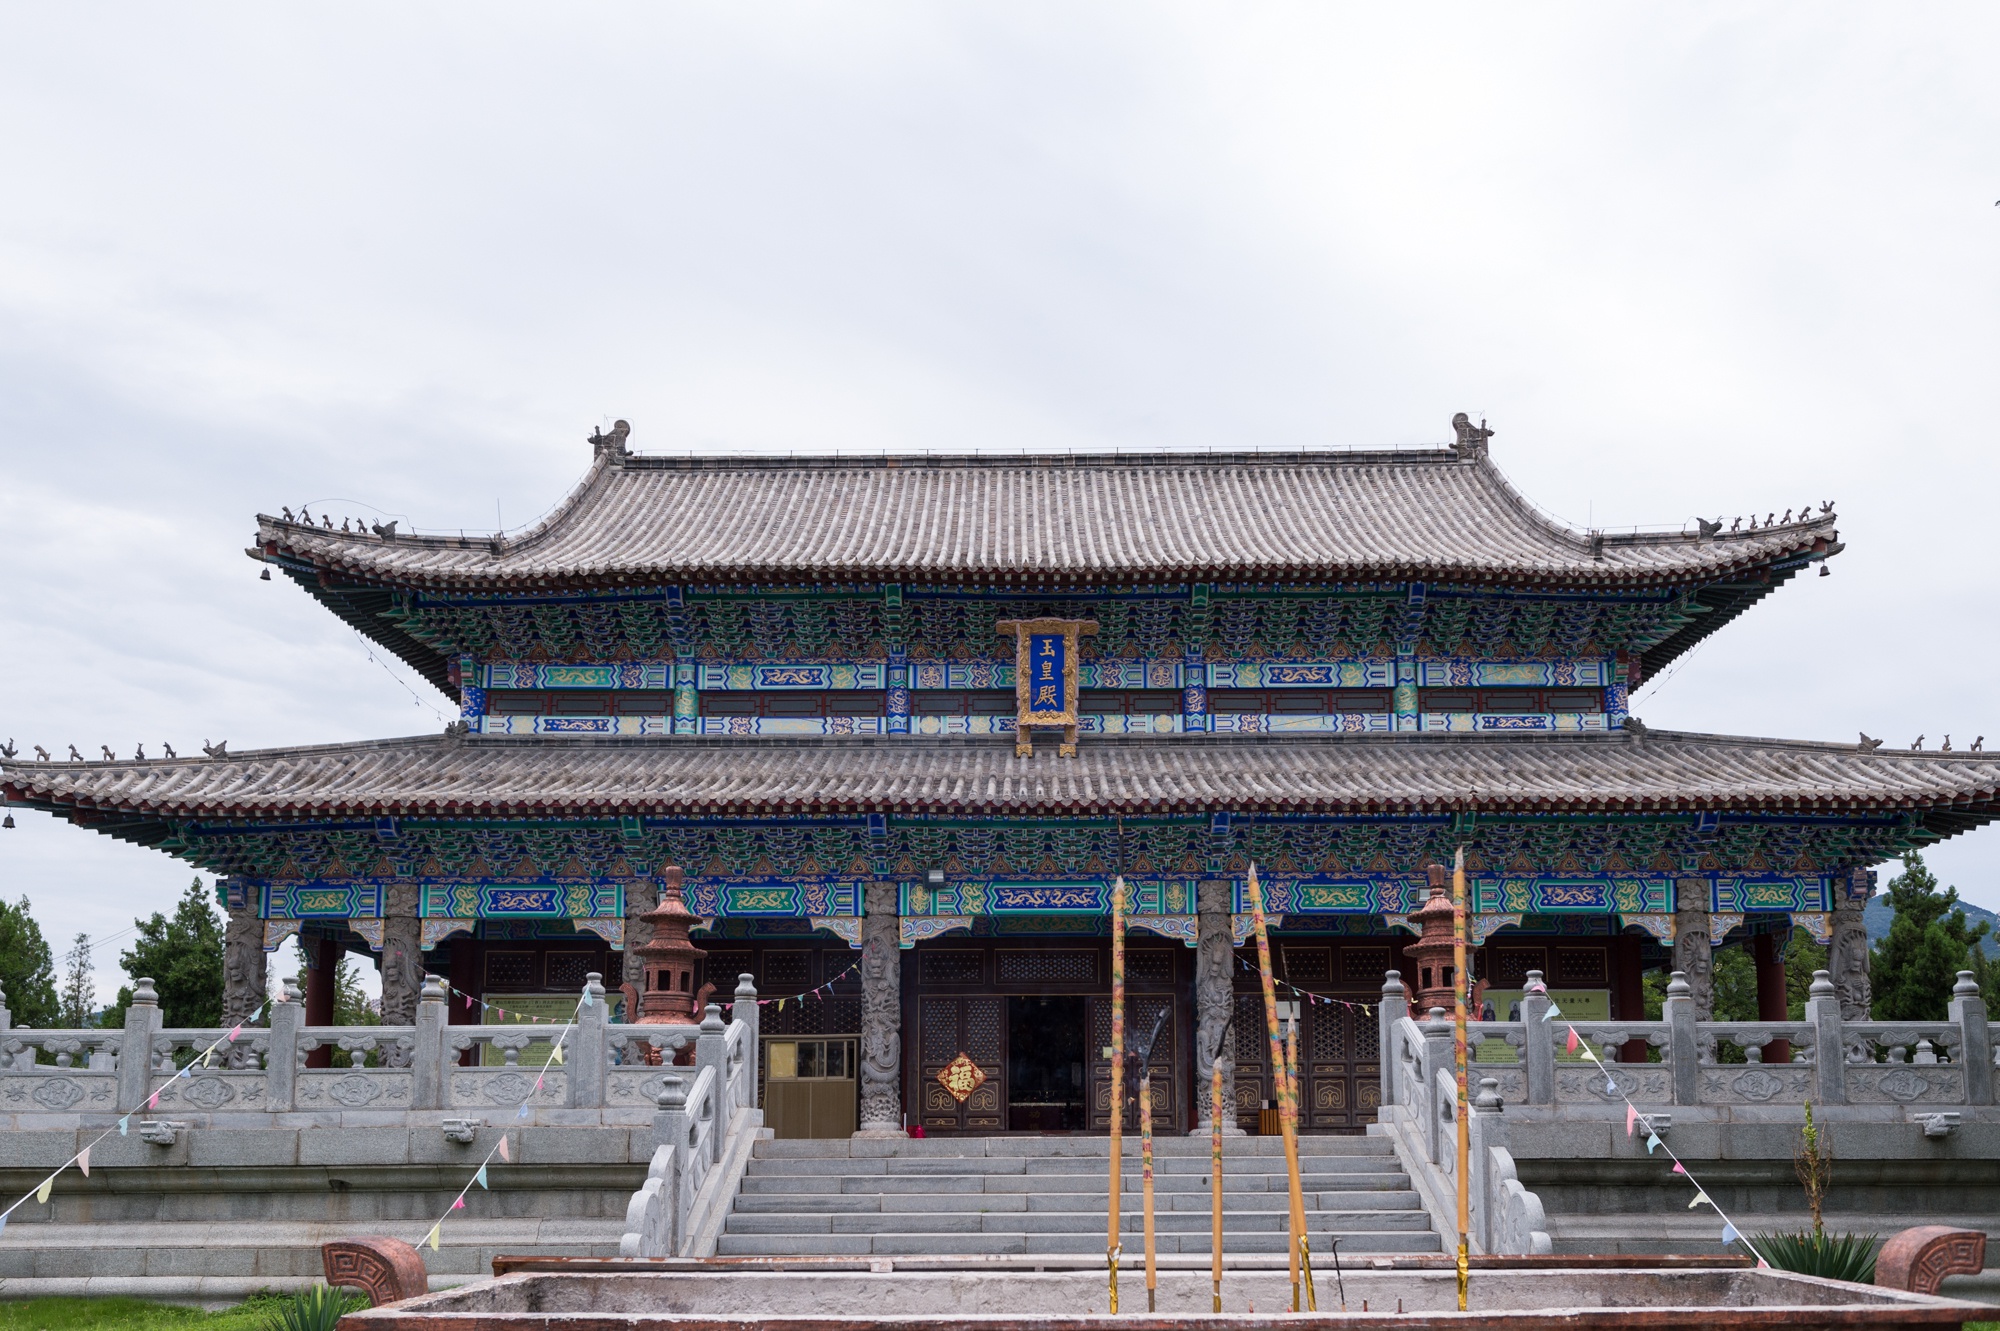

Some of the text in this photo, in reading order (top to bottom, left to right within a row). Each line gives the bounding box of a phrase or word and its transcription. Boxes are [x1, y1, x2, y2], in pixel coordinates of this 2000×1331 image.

[1034, 639, 1058, 708] 玉皇殿
[949, 1065, 976, 1092] 福
